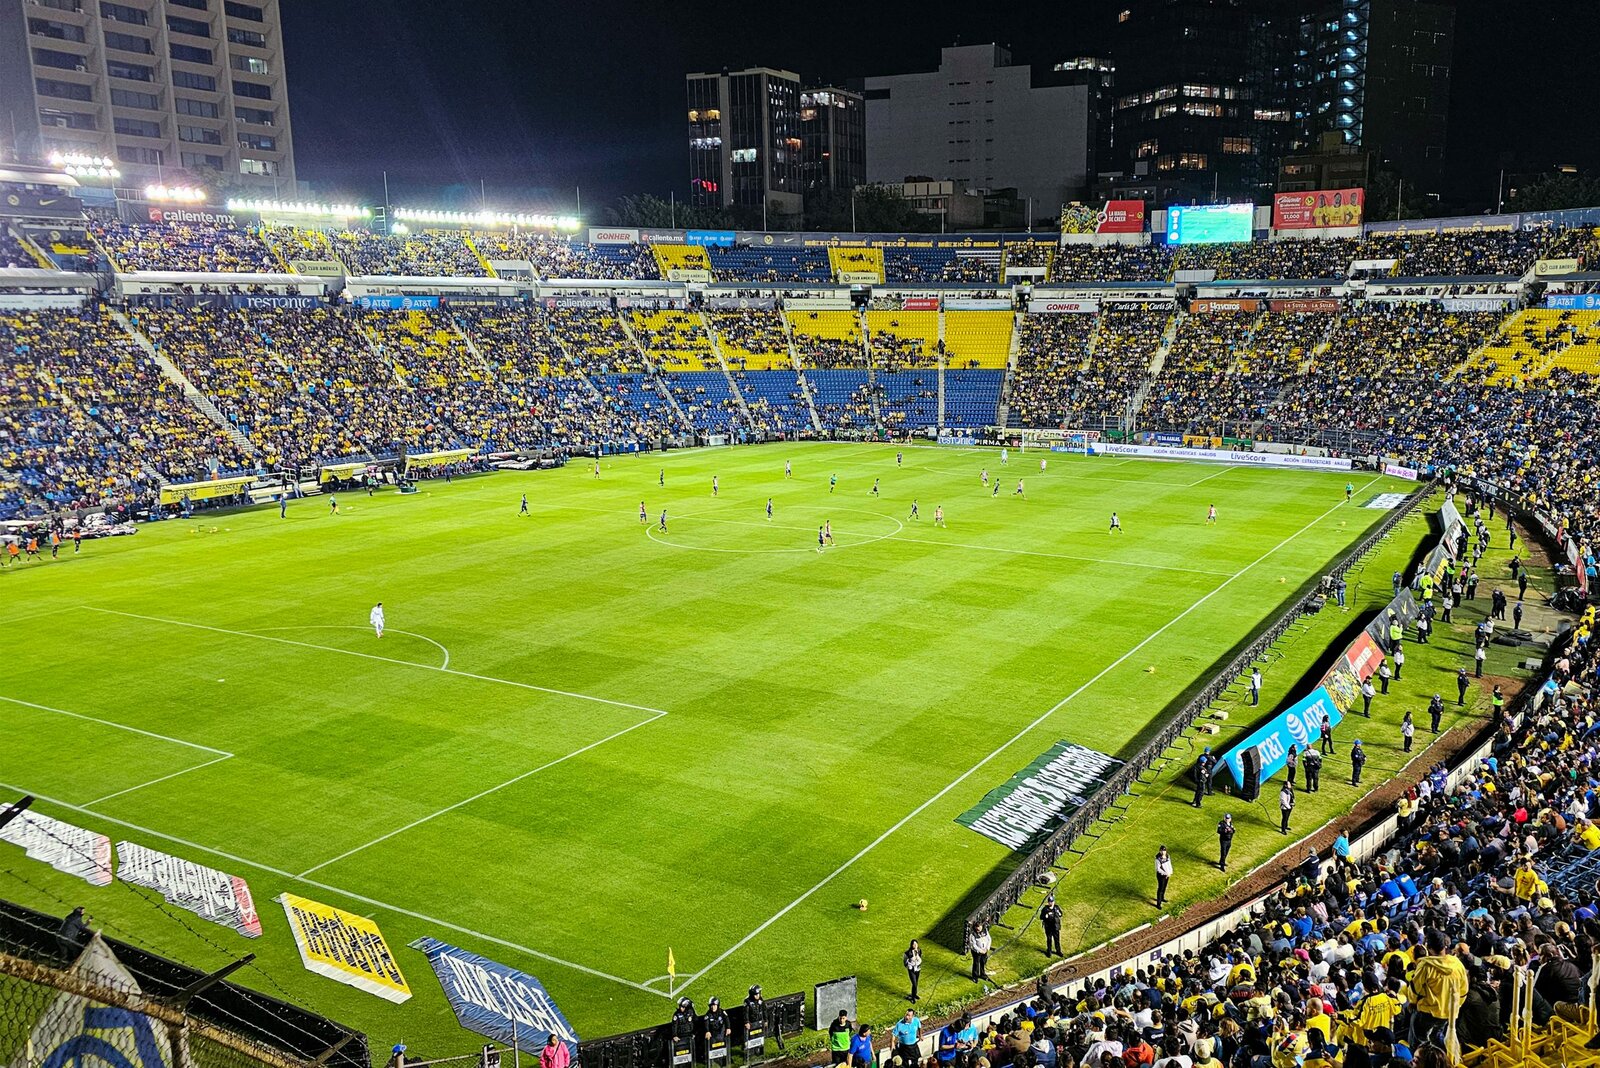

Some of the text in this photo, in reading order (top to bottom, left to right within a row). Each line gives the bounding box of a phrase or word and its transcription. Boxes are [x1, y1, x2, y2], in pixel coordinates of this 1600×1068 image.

[163, 210, 236, 224] caliente.mx
[247, 296, 311, 309] restonic
[372, 299, 390, 307] AT&T
[414, 299, 431, 307] AT&T
[557, 298, 607, 307] caliente.mx
[1105, 445, 1138, 453] LiveScore
[1231, 453, 1266, 462] LiveScore
[1302, 699, 1328, 733] AT&T
[1260, 731, 1285, 769] AT&T
